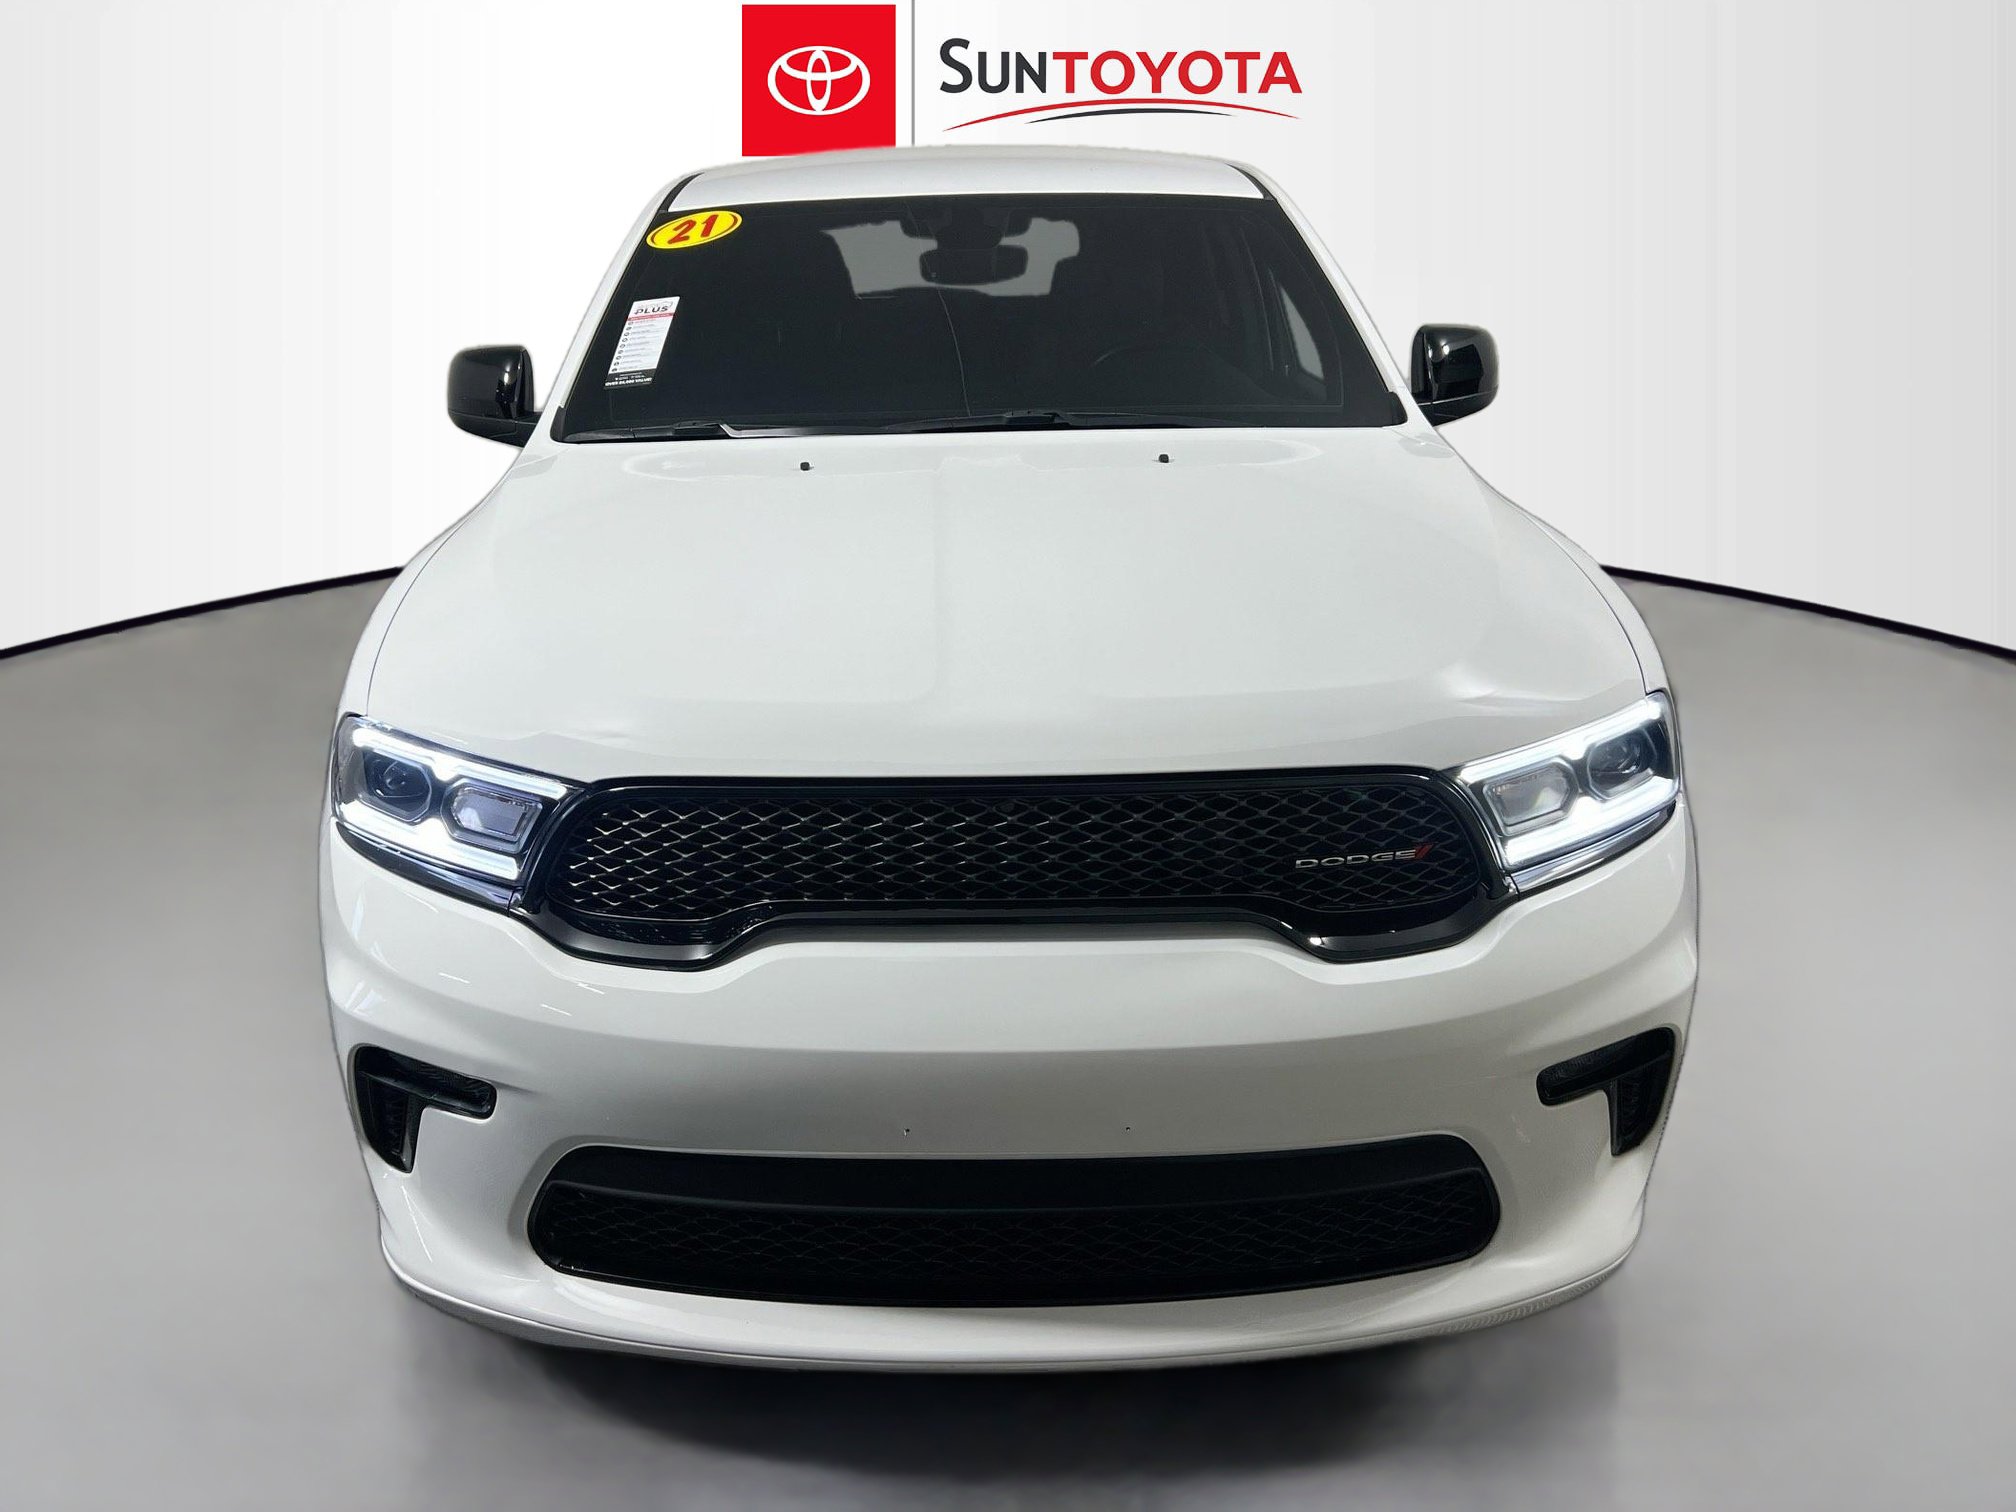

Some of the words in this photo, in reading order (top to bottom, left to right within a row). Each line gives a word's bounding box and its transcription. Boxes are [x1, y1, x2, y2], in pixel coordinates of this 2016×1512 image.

[667, 214, 719, 244] 21
[634, 305, 668, 315] PLUS
[1295, 849, 1416, 869] DODGE
